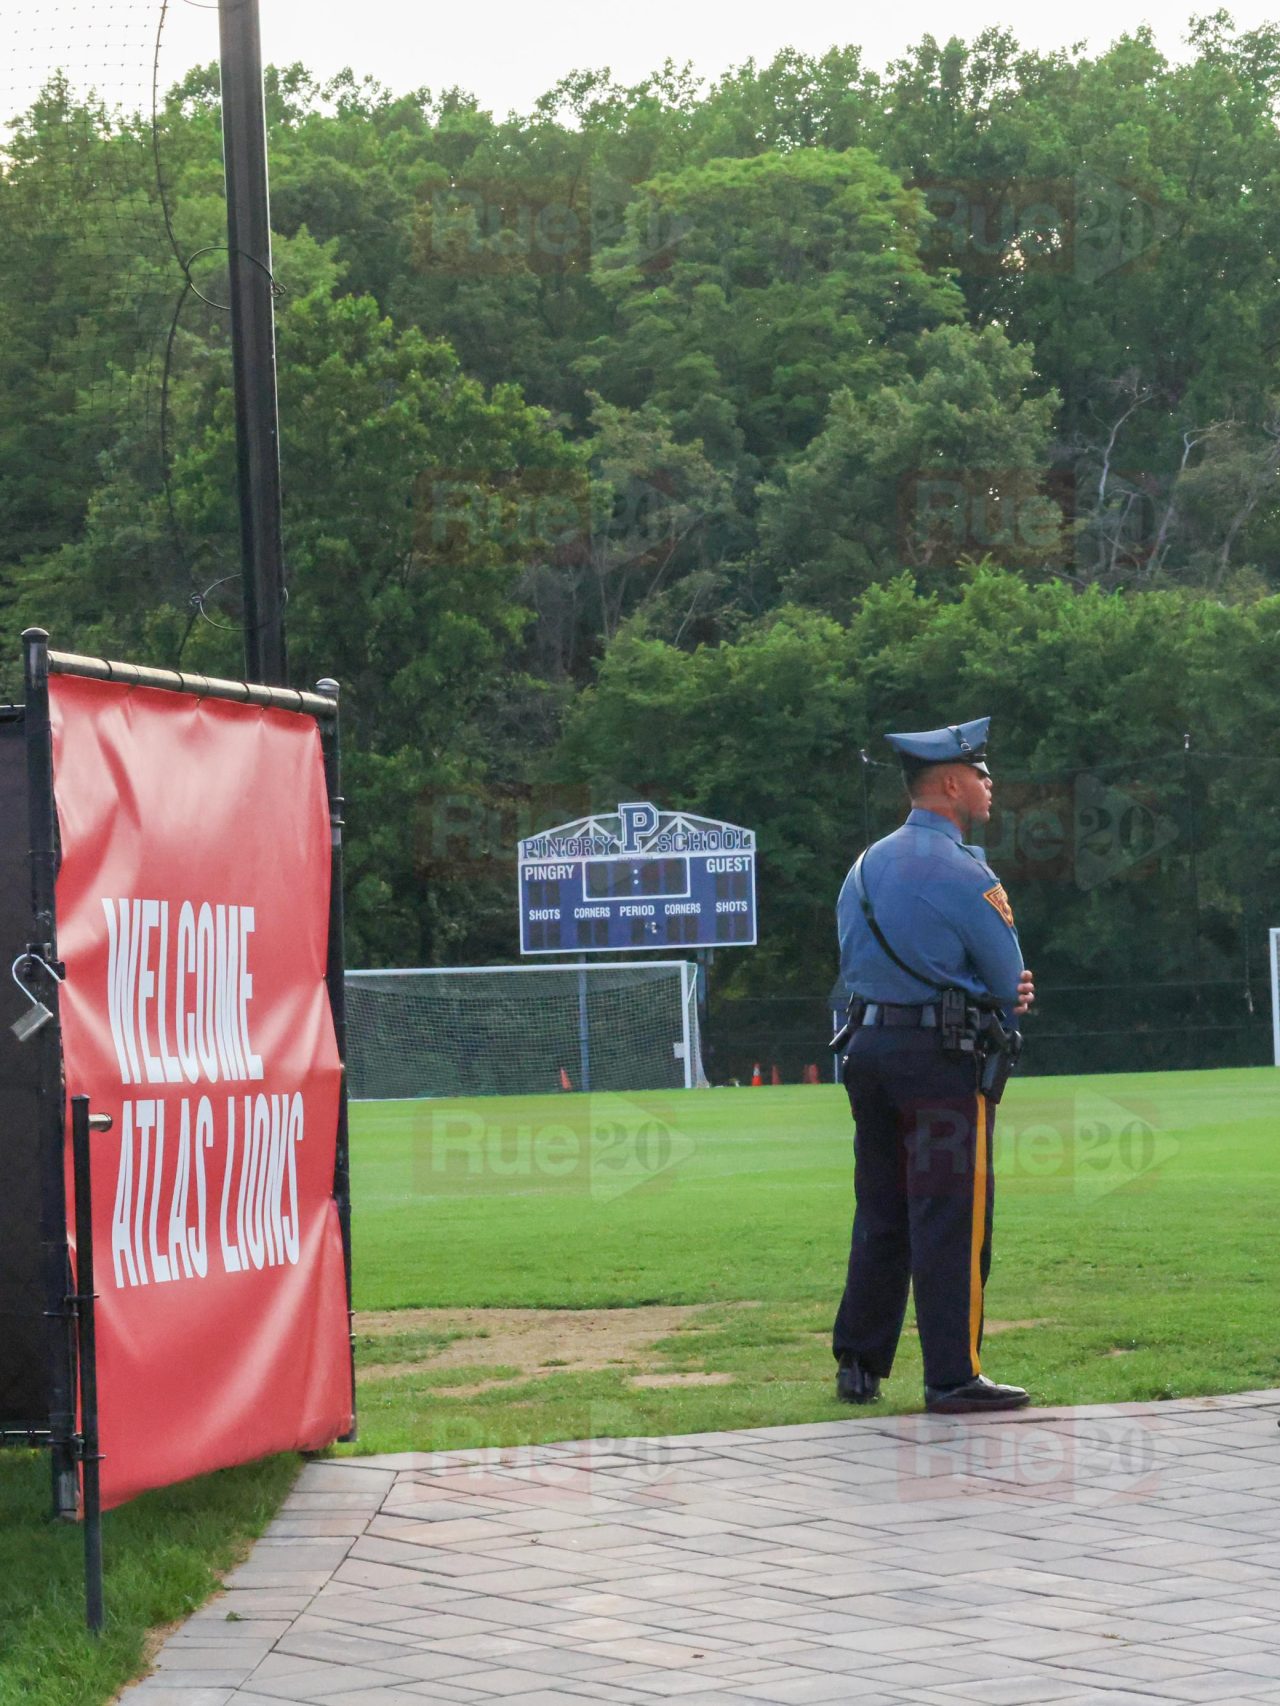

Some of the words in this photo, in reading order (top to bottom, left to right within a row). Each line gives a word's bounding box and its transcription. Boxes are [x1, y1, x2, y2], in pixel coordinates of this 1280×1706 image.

[618, 802, 659, 854] P
[522, 834, 617, 860] PINGRY
[657, 829, 752, 853] SCHOOL
[525, 864, 574, 881] PINGRY
[706, 857, 751, 873] GUEST
[529, 908, 561, 921] SHOTS
[574, 906, 611, 919] CORNERS
[620, 904, 655, 917] PERIOD
[664, 902, 701, 915] CORNERS
[716, 901, 748, 913] SHOTS
[101, 897, 264, 1085] WELCOME
[112, 1095, 214, 1289] ATLAS
[219, 1091, 304, 1273] LIONS
